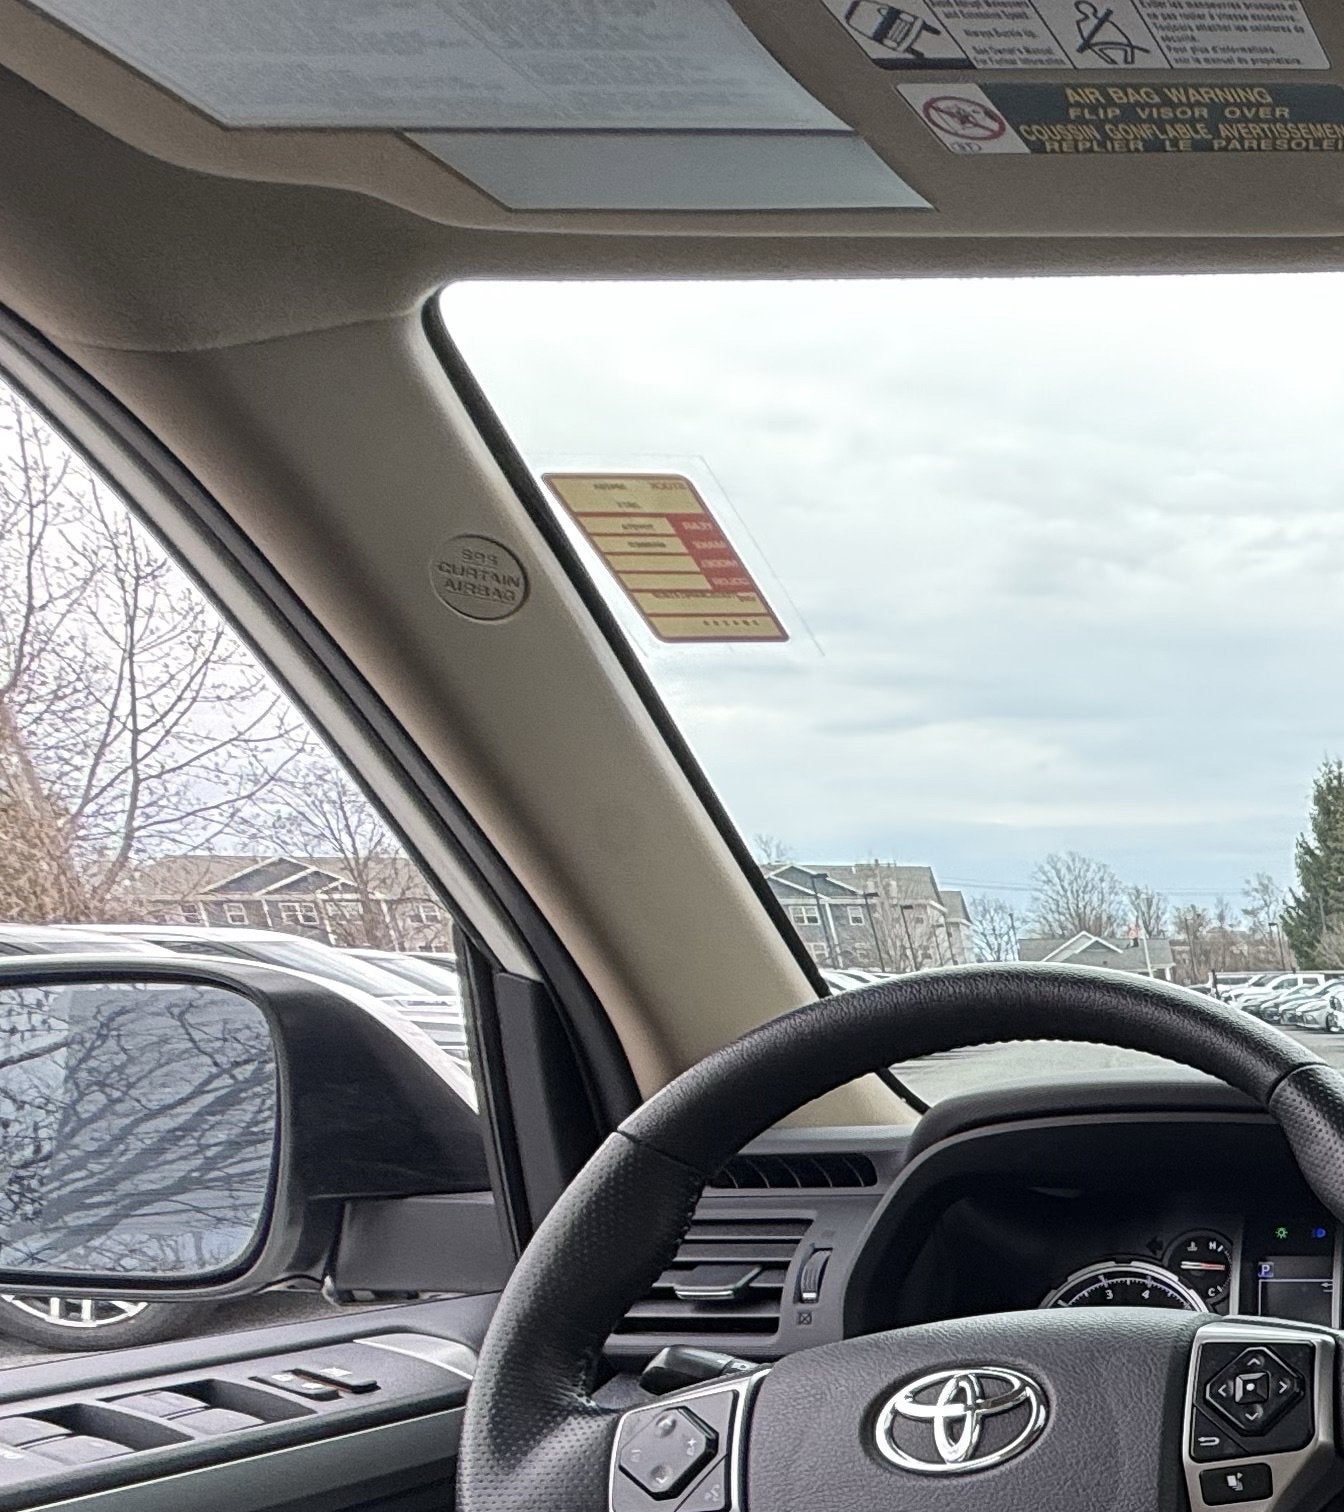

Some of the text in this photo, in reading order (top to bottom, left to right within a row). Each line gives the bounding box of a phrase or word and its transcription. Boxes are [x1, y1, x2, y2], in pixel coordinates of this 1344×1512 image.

[1066, 87, 1273, 104] AIR BAG WARNING
[1068, 107, 1290, 119] FLIP VISOR OVER
[1019, 124, 1102, 142] COUSSIN
[1105, 123, 1213, 140] GONFLABLE
[1045, 140, 1144, 153] REPLIER
[1165, 139, 1192, 151] LE
[437, 561, 520, 588] CURTAIN
[444, 579, 517, 603] AIRBAG
[1260, 1264, 1271, 1275] P
[1105, 1289, 1114, 1300] 3
[1141, 1289, 1150, 1300] 4
